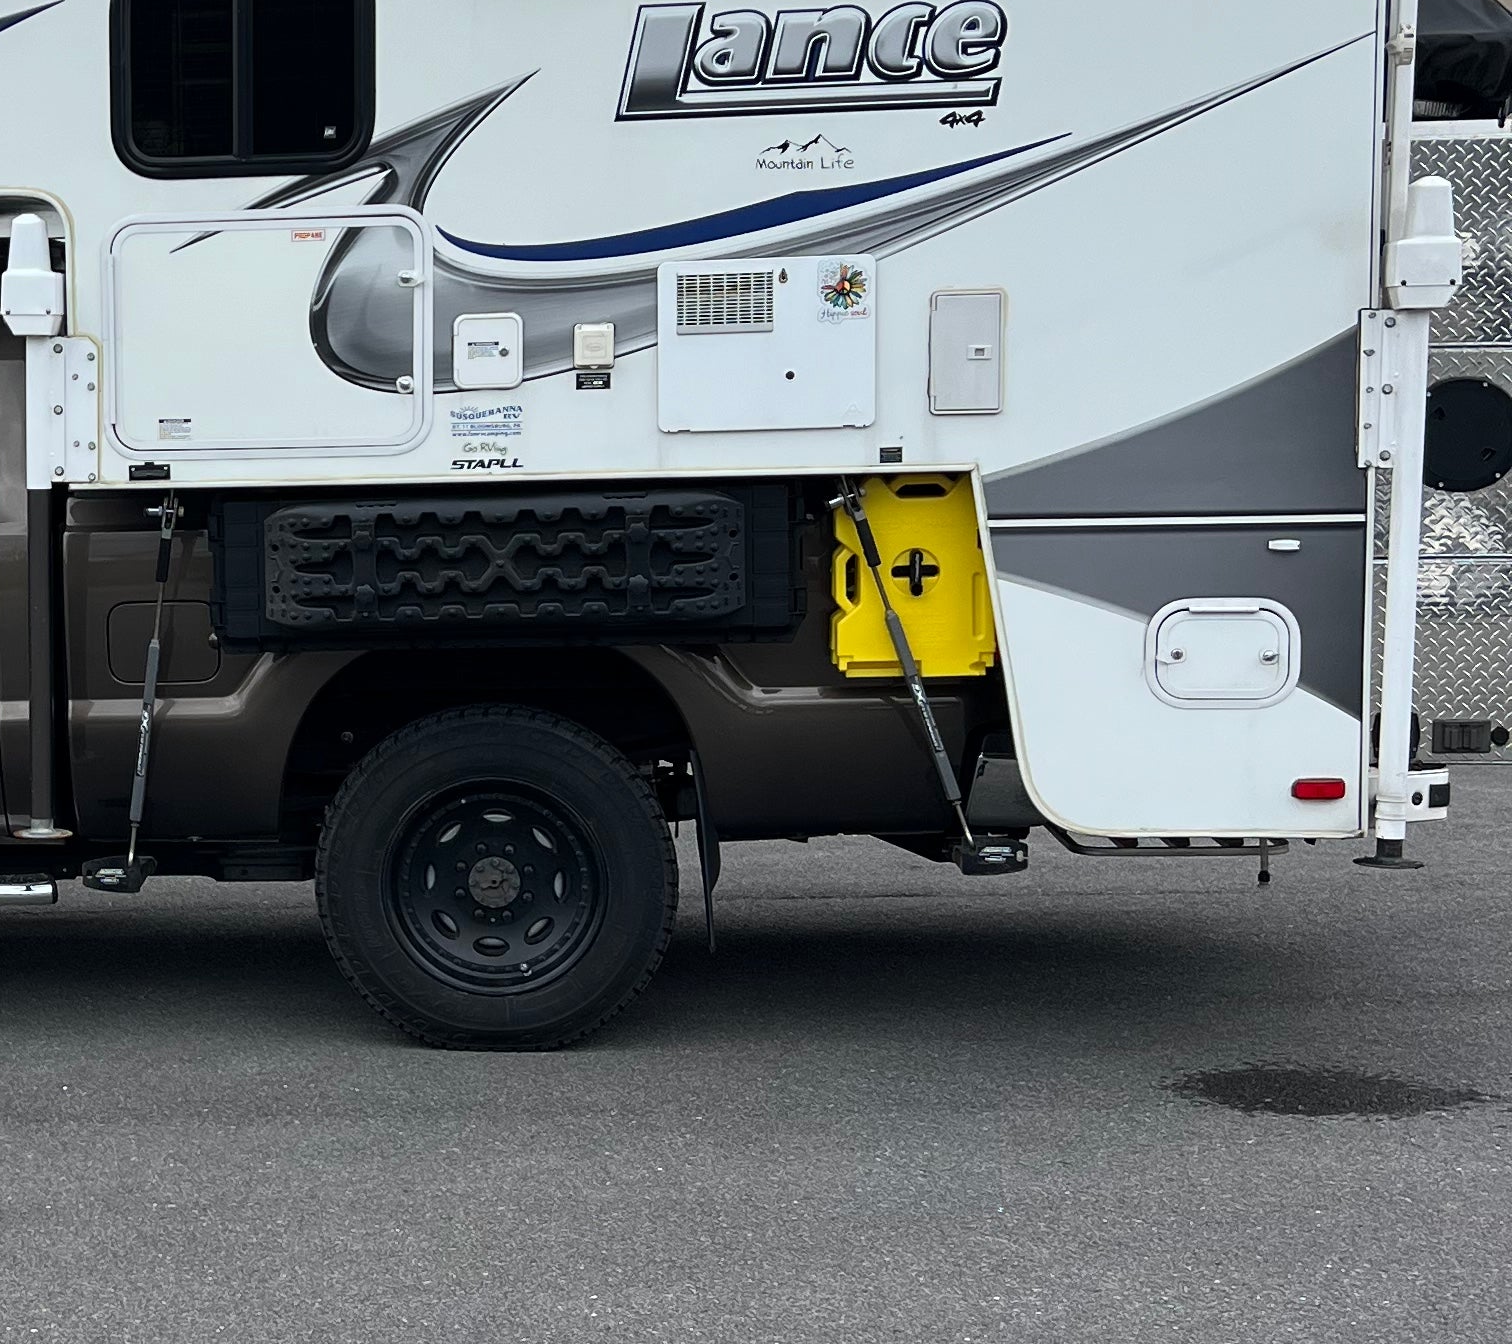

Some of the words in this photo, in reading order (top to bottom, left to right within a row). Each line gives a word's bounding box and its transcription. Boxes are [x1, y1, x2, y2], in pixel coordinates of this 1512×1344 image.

[615, 0, 1007, 122] Lance
[939, 110, 986, 129] 4x4
[756, 157, 814, 170] Mountain
[820, 153, 855, 170] Life
[450, 406, 522, 420] SUSQUEHANNA
[450, 458, 524, 470] STAPLL
